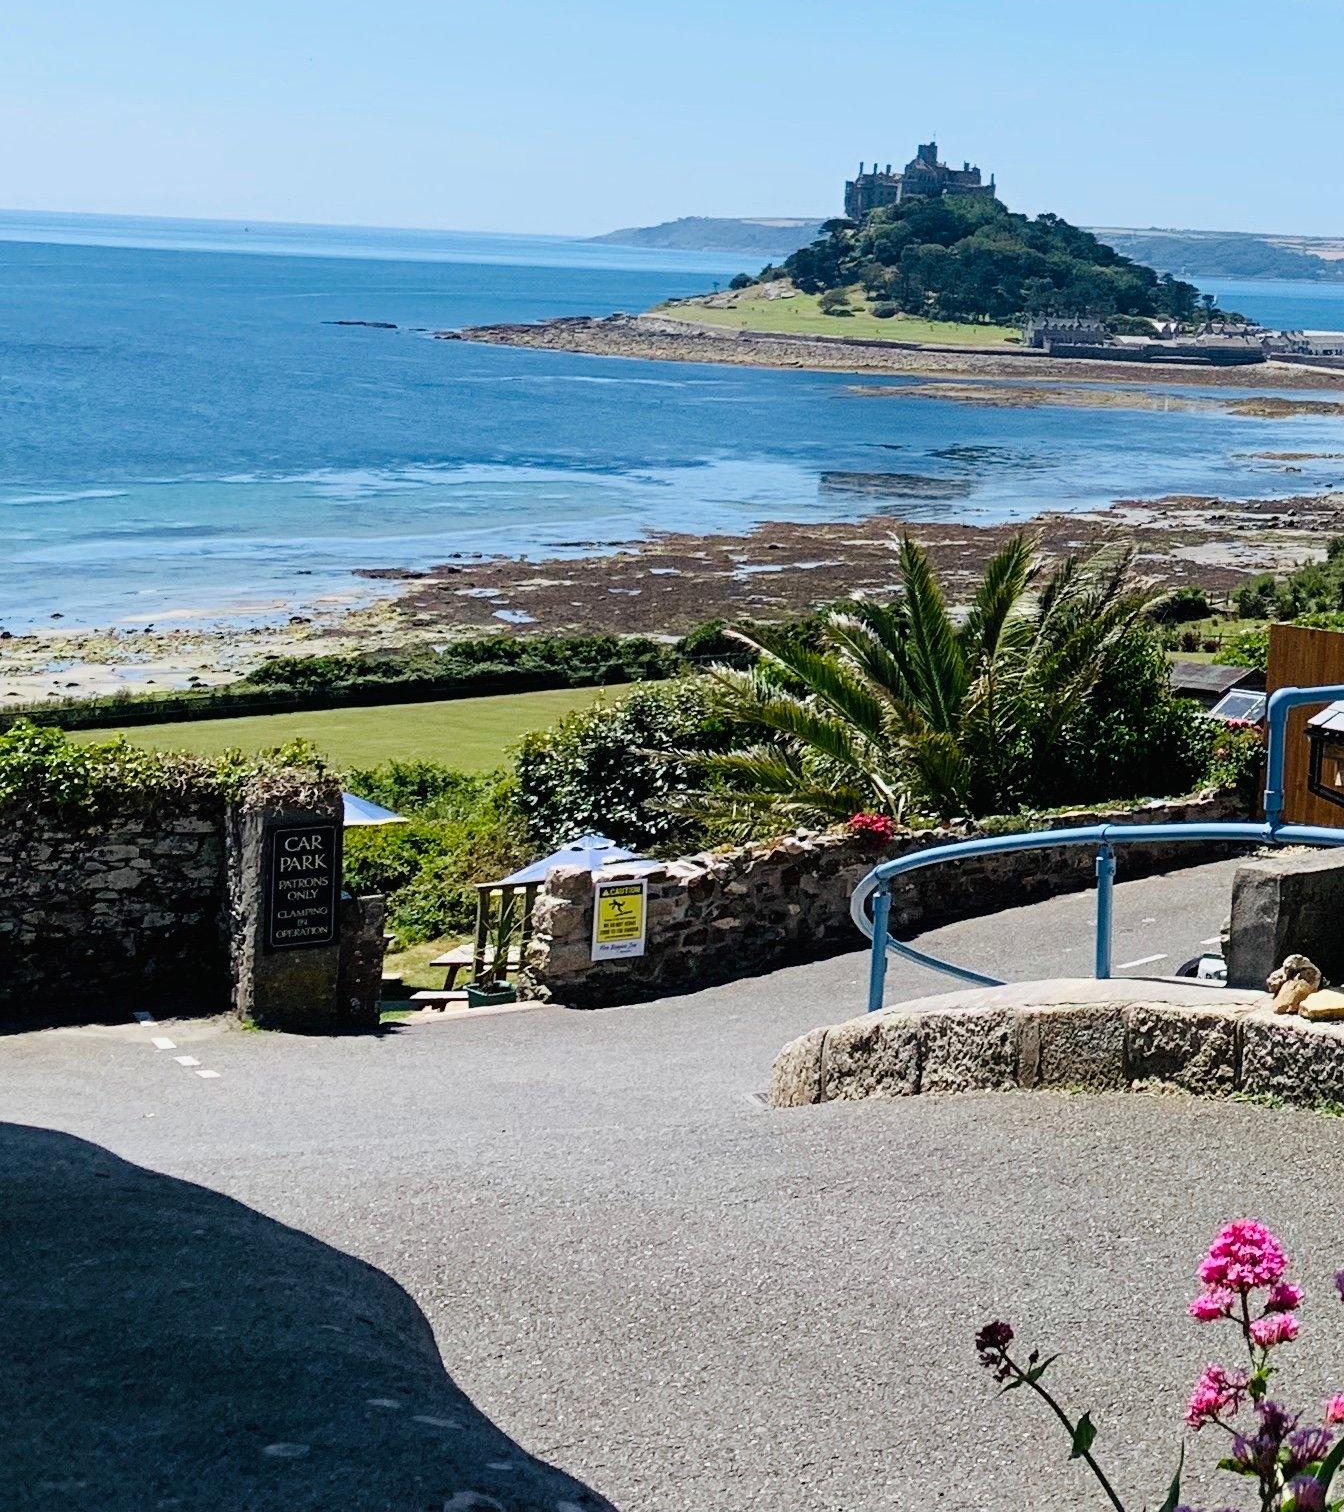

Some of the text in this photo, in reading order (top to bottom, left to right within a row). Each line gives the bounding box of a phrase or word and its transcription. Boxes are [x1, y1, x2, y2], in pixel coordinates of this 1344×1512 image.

[285, 835, 322, 852] CAR
[280, 853, 328, 873] PARK
[279, 876, 328, 890] PATRONS
[287, 889, 319, 901] ONLY
[278, 906, 328, 919] CLAMPING
[276, 926, 328, 939] OPERATION
